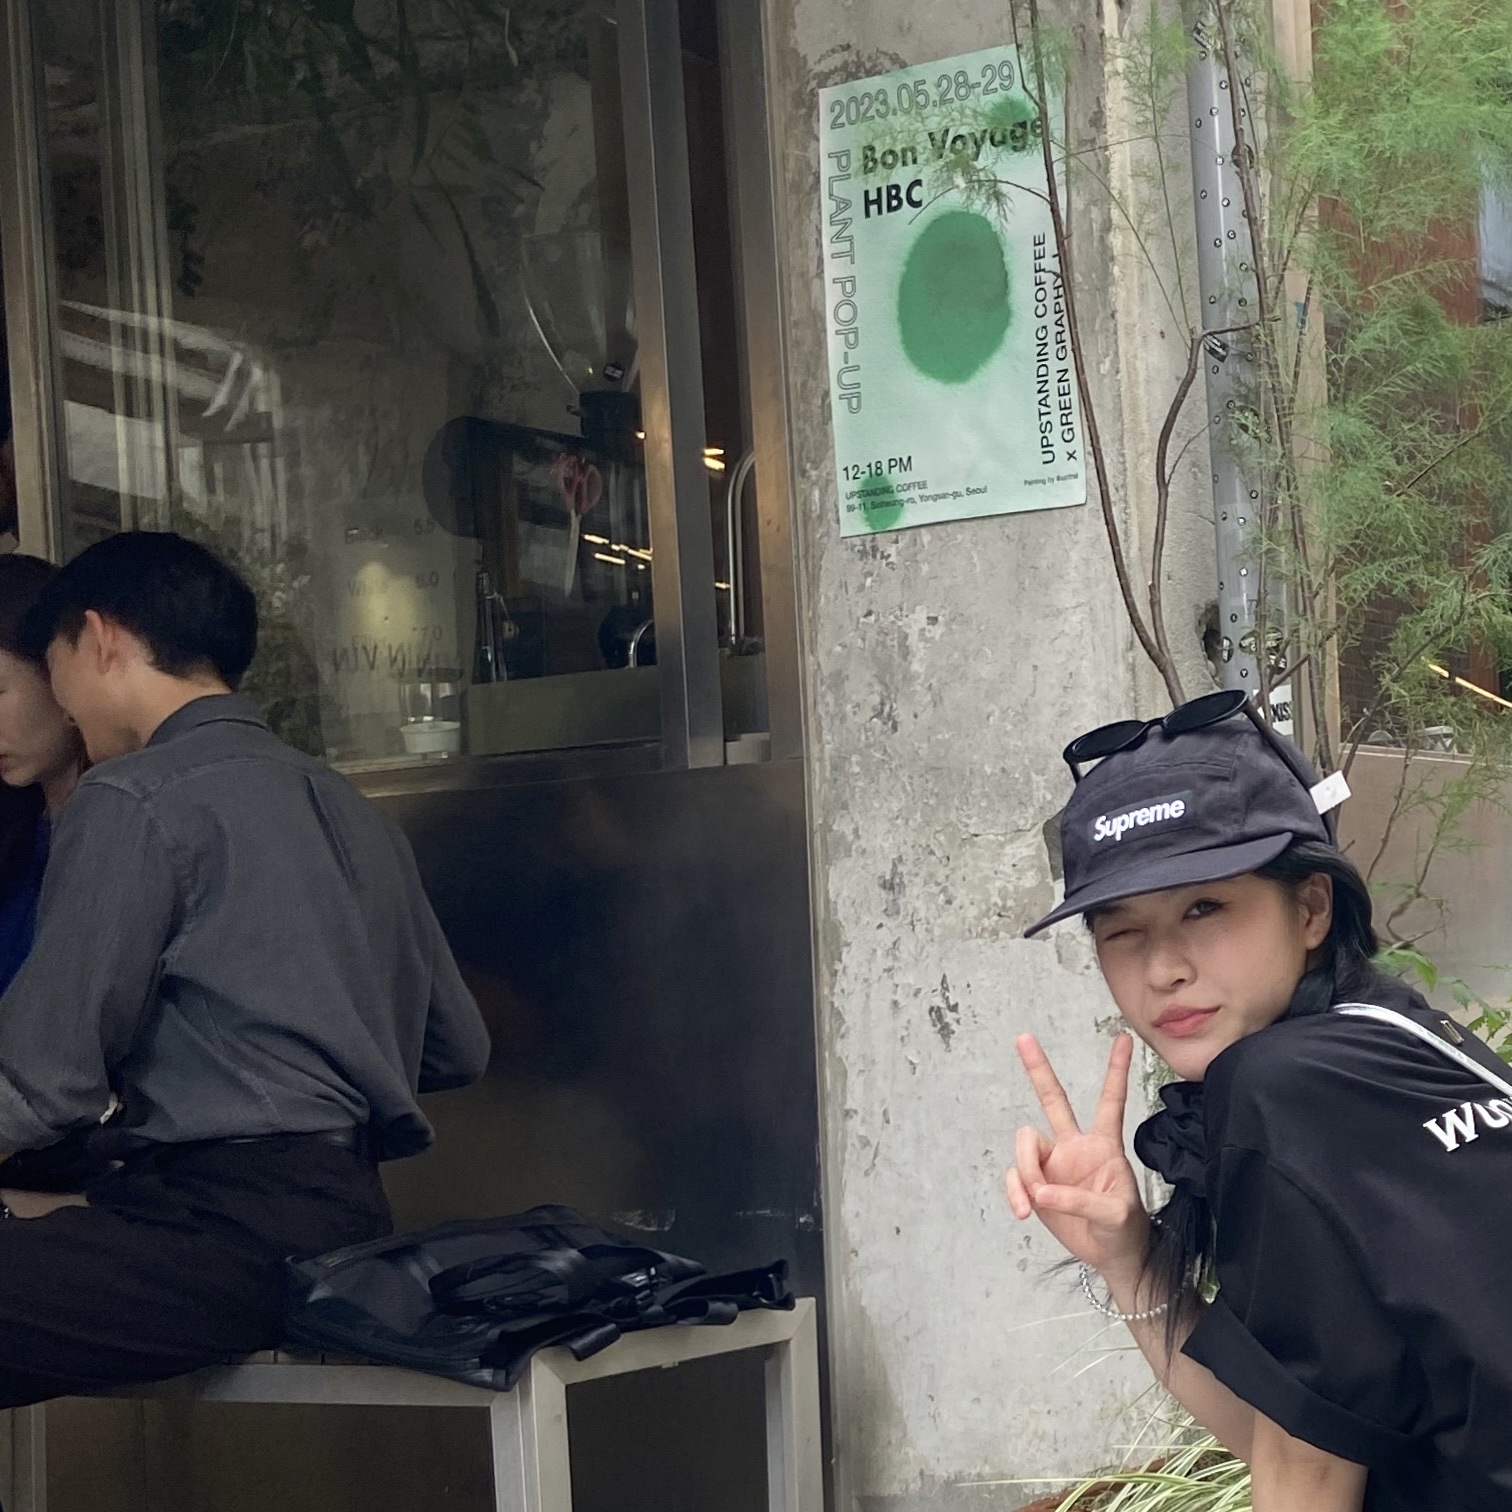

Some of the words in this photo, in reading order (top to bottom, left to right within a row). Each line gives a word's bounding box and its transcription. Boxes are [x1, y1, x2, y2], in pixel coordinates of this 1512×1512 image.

[830, 60, 1015, 130] 2023.05.28-29
[862, 144, 918, 176] Bon
[927, 116, 1044, 162] Voyage
[828, 149, 856, 265] PLANT
[863, 178, 924, 219] HBC
[1033, 232, 1048, 319] COFFEE
[832, 275, 863, 415] POP-UP
[1035, 325, 1056, 466] UPSTANDING
[1056, 368, 1076, 444] GREEN
[842, 460, 884, 481] 12-18
[887, 455, 913, 474] PM
[895, 480, 928, 493] COFFEE
[965, 484, 988, 497] Seoul
[1094, 799, 1186, 842] Supreme
